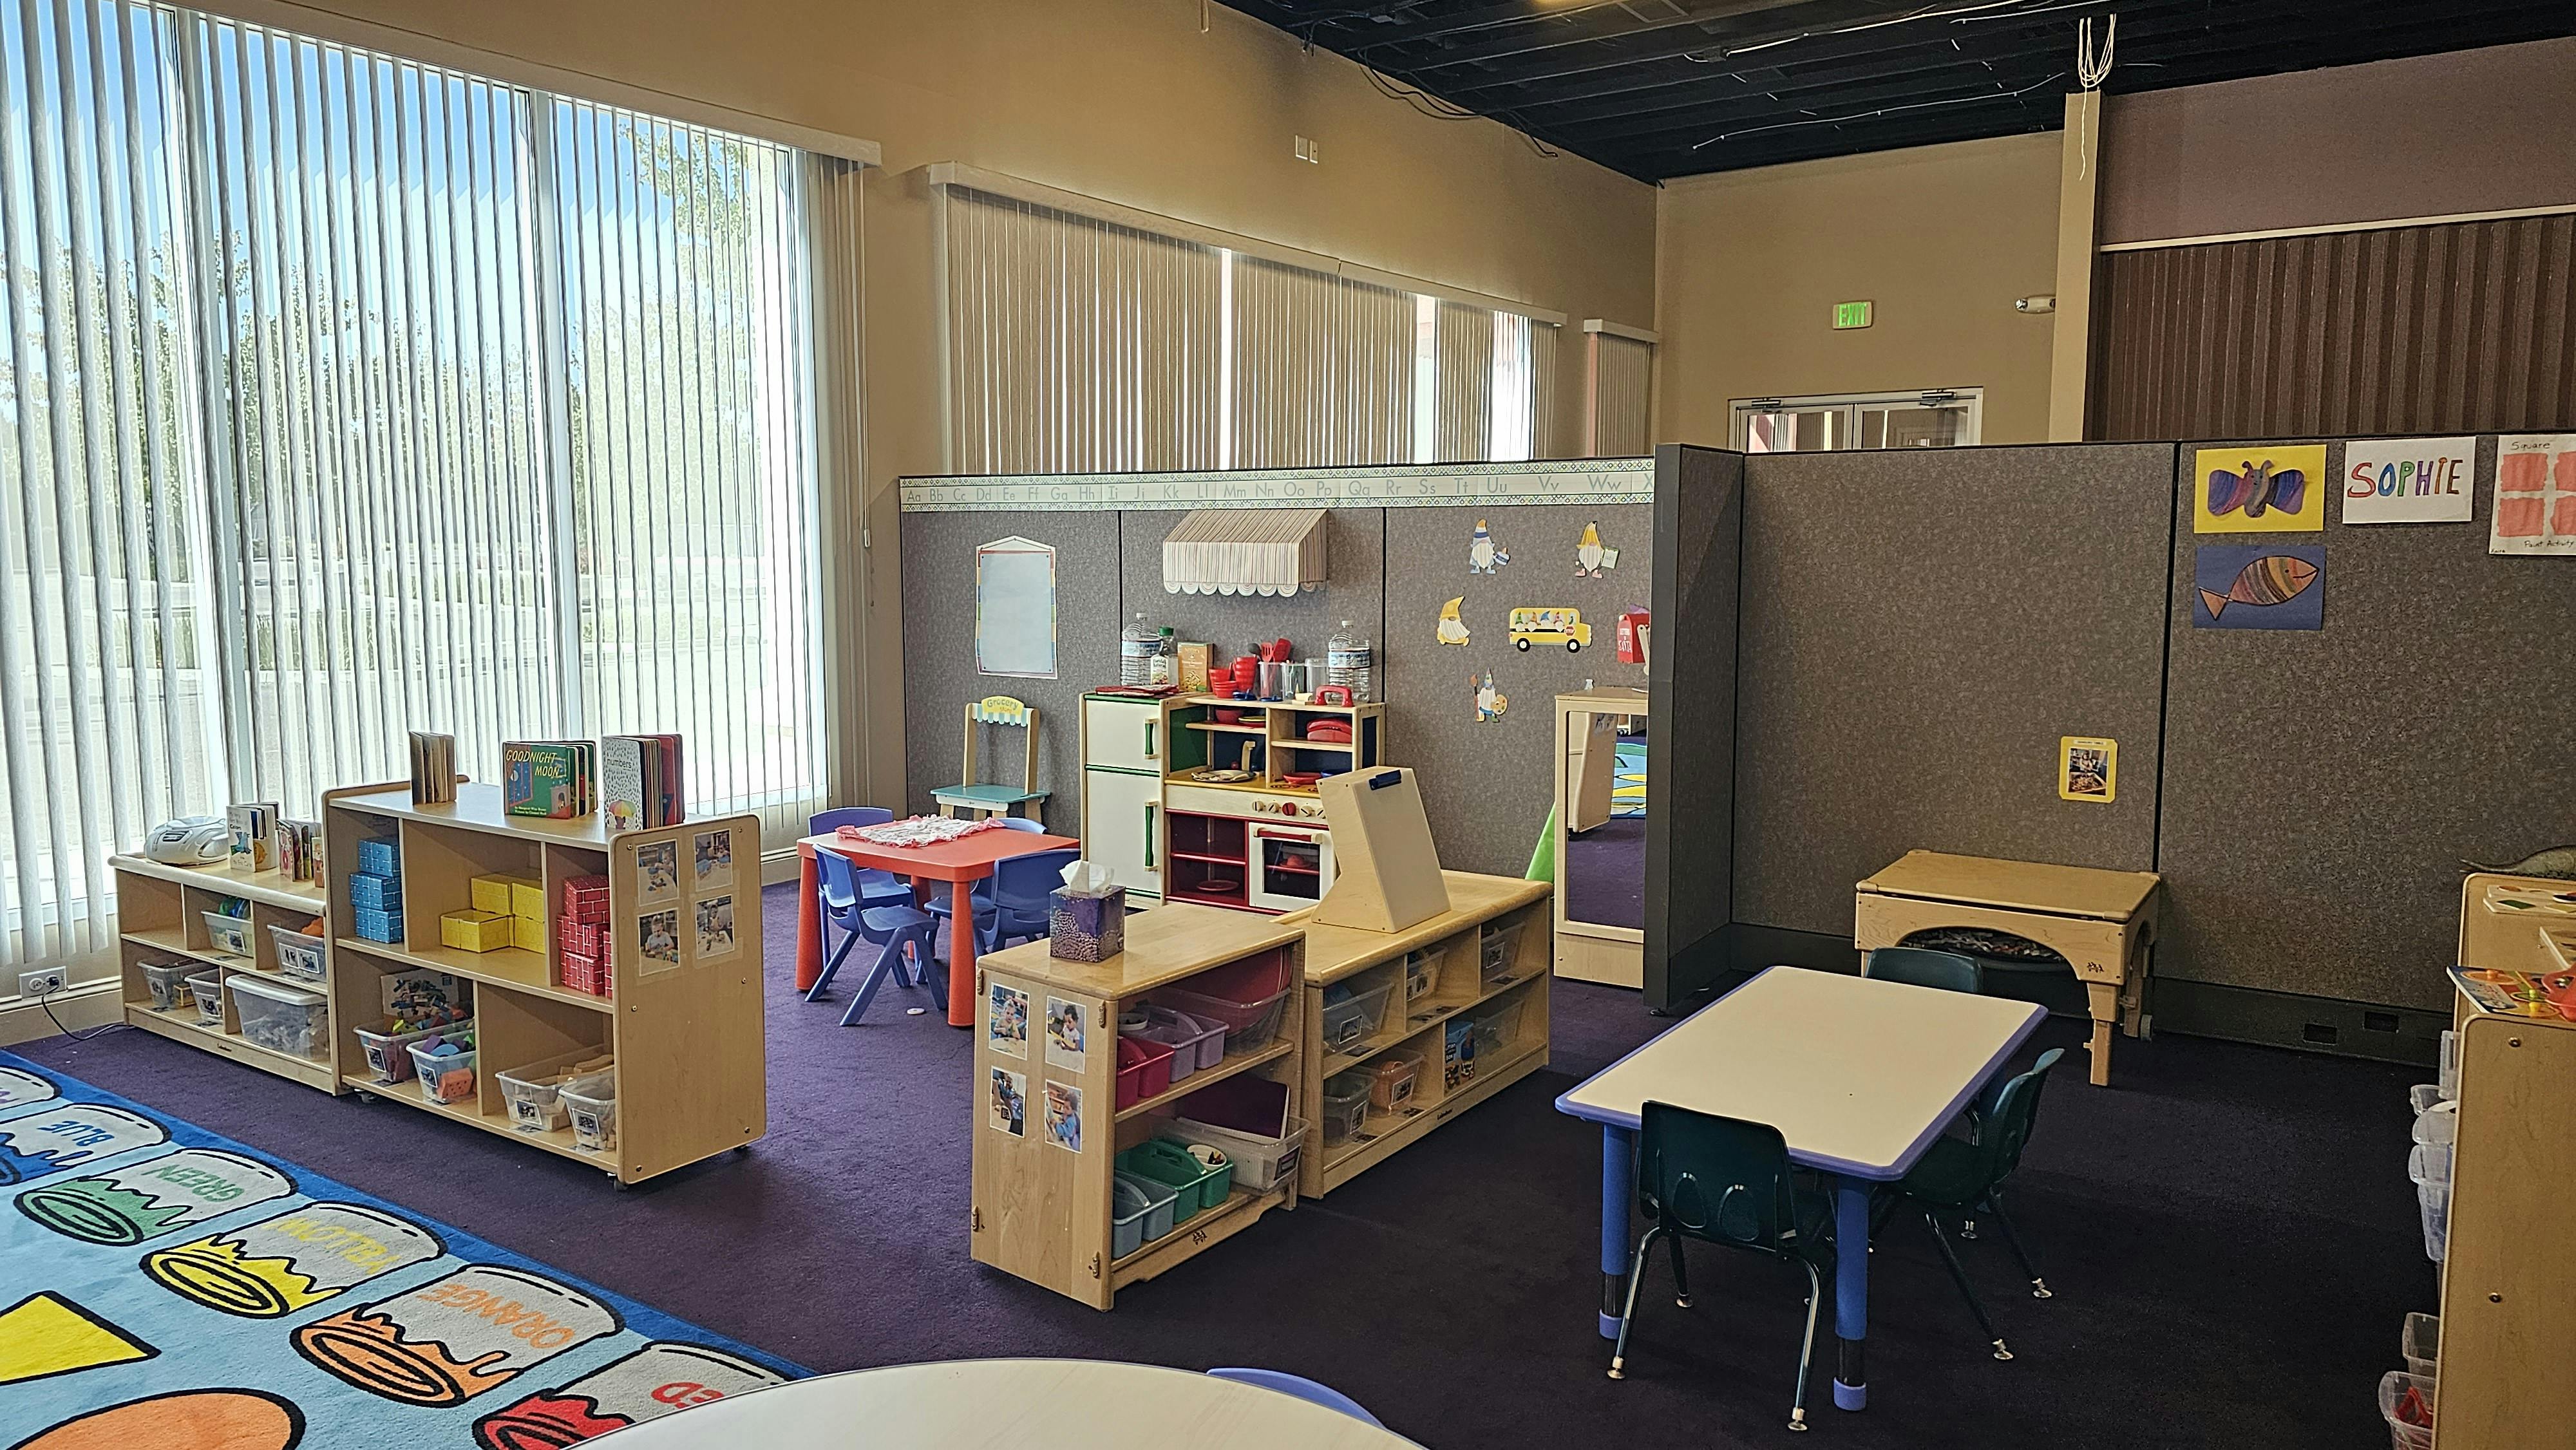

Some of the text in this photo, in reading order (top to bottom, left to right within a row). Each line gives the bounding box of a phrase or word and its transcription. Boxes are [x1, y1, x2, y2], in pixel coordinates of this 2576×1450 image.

[1838, 303, 1867, 326] EXIT
[2510, 441, 2550, 451] Square
[907, 490, 921, 502] Aa
[929, 489, 943, 502] Bb
[953, 488, 967, 501] Cc
[976, 488, 992, 501] Dd
[1003, 488, 1016, 500] Ee
[1028, 487, 1039, 500] Ff
[1050, 487, 1068, 503] Gg
[1079, 486, 1095, 500] Hh
[1108, 485, 1118, 500] Ii
[1134, 485, 1144, 502] Jj
[1164, 484, 1179, 499] Kk
[1197, 484, 1208, 498] Ll
[1224, 484, 1246, 498] Mm
[1256, 482, 1274, 497] Nn
[1283, 482, 1305, 496] Oo
[1317, 481, 1332, 500] Pp
[1349, 480, 1370, 500] Qq
[1387, 480, 1401, 495] Rr
[1419, 478, 1436, 494] Ss
[1454, 478, 1468, 494] Tt
[1487, 477, 1507, 493] Uu
[1538, 475, 1559, 492] Vv
[1587, 474, 1622, 491] Ww
[2347, 457, 2463, 498] SOPHIE
[2546, 539, 2574, 549] Activity
[987, 699, 1019, 710] Grocery
[506, 749, 557, 764] GOODNIGHT
[607, 758, 632, 769] numbers
[535, 765, 560, 777] MOON
[37, 1120, 115, 1147] BLUE
[141, 1163, 245, 1203] GREEN
[261, 1217, 402, 1275] YELLOW
[416, 1283, 575, 1349] ORANGE
[650, 1382, 726, 1409] ED
